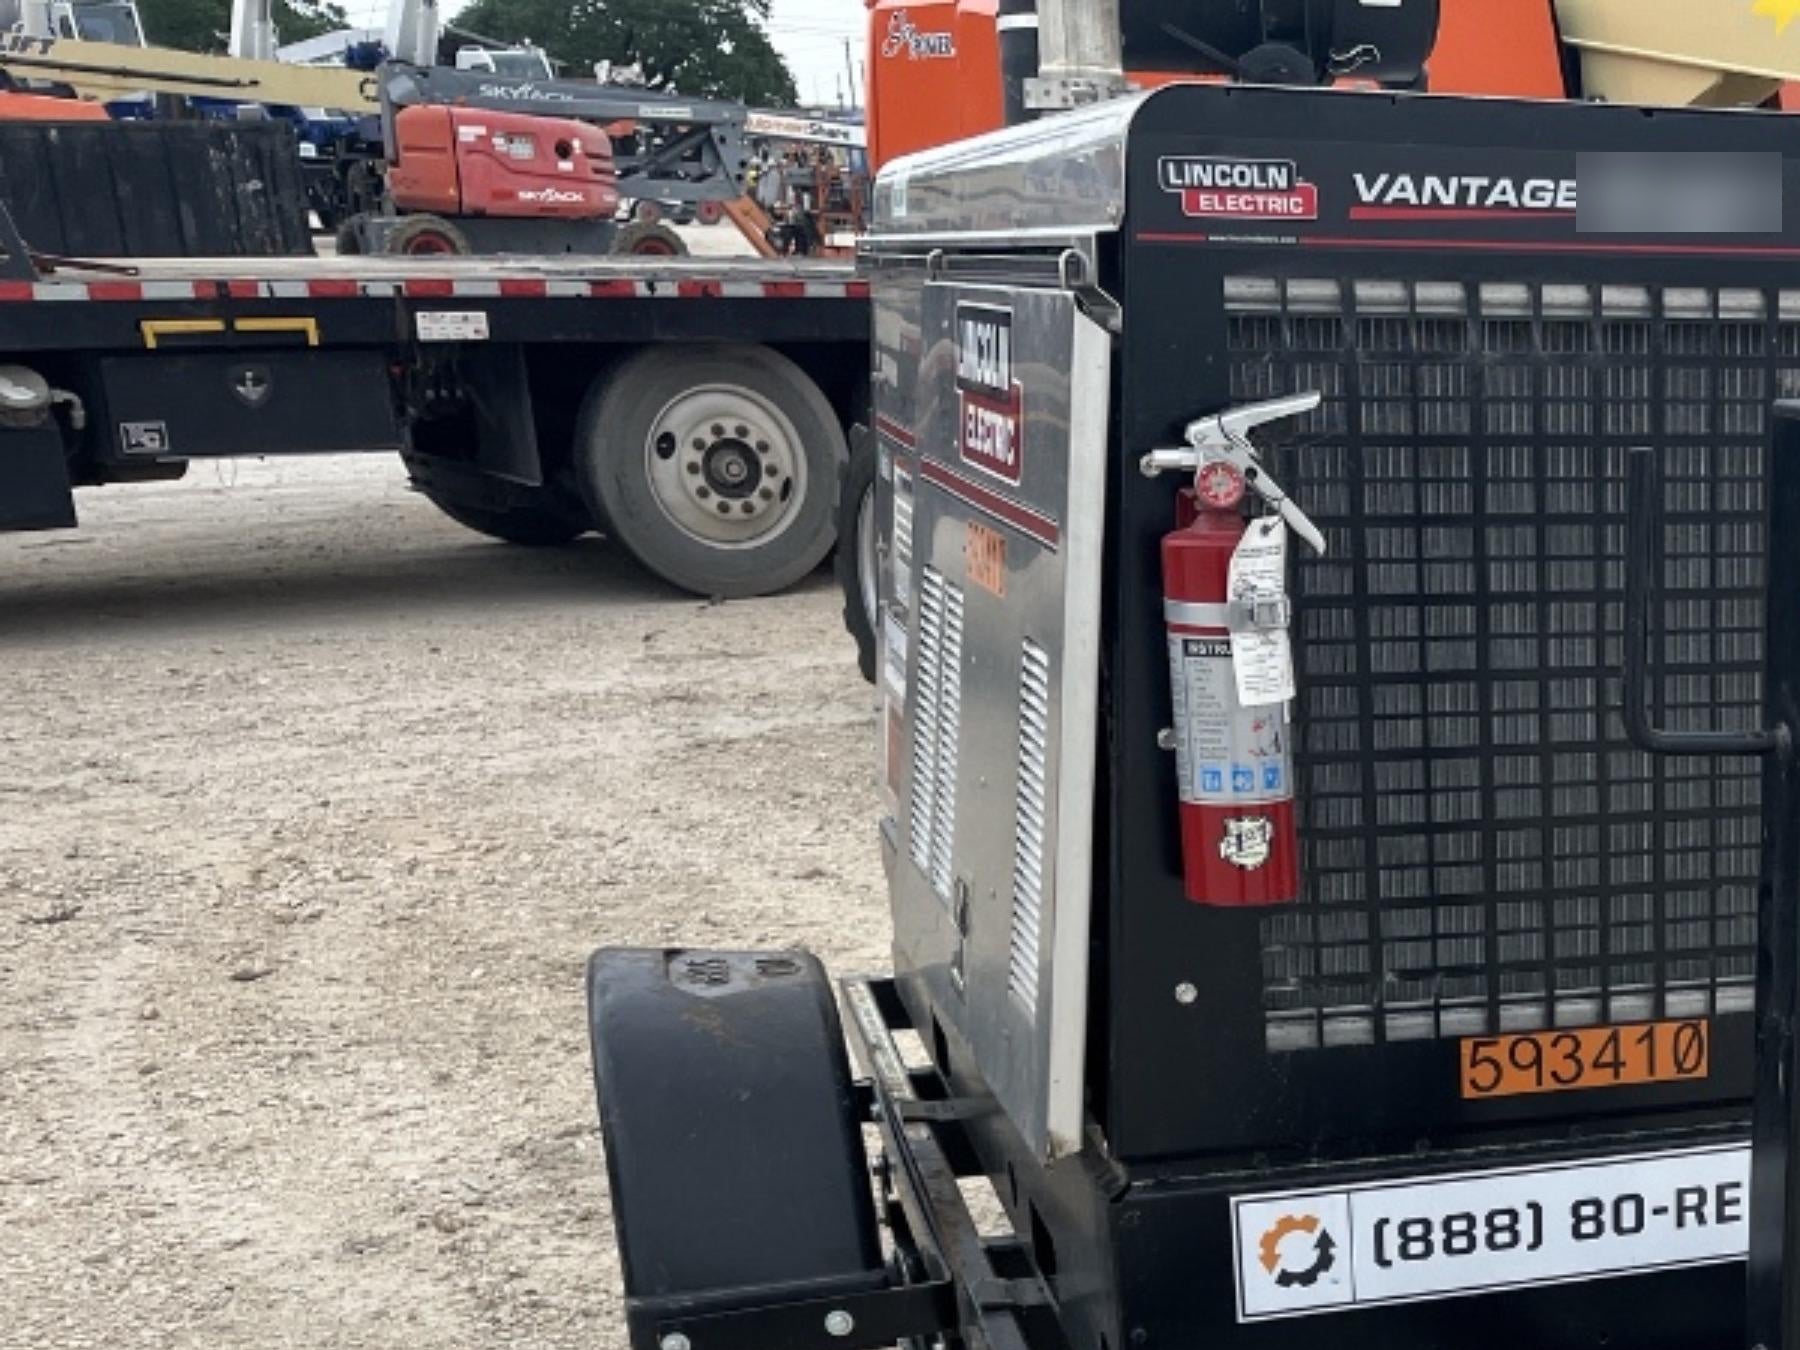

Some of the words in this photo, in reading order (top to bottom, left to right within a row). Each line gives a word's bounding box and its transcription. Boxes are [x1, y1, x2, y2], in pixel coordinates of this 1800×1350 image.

[1167, 161, 1289, 189] LINCOLN
[1353, 173, 1577, 208] VANTAGE
[1199, 193, 1303, 213] ELECTRIC
[1467, 1022, 1706, 1092] 593410
[1373, 1201, 1543, 1267] (888)
